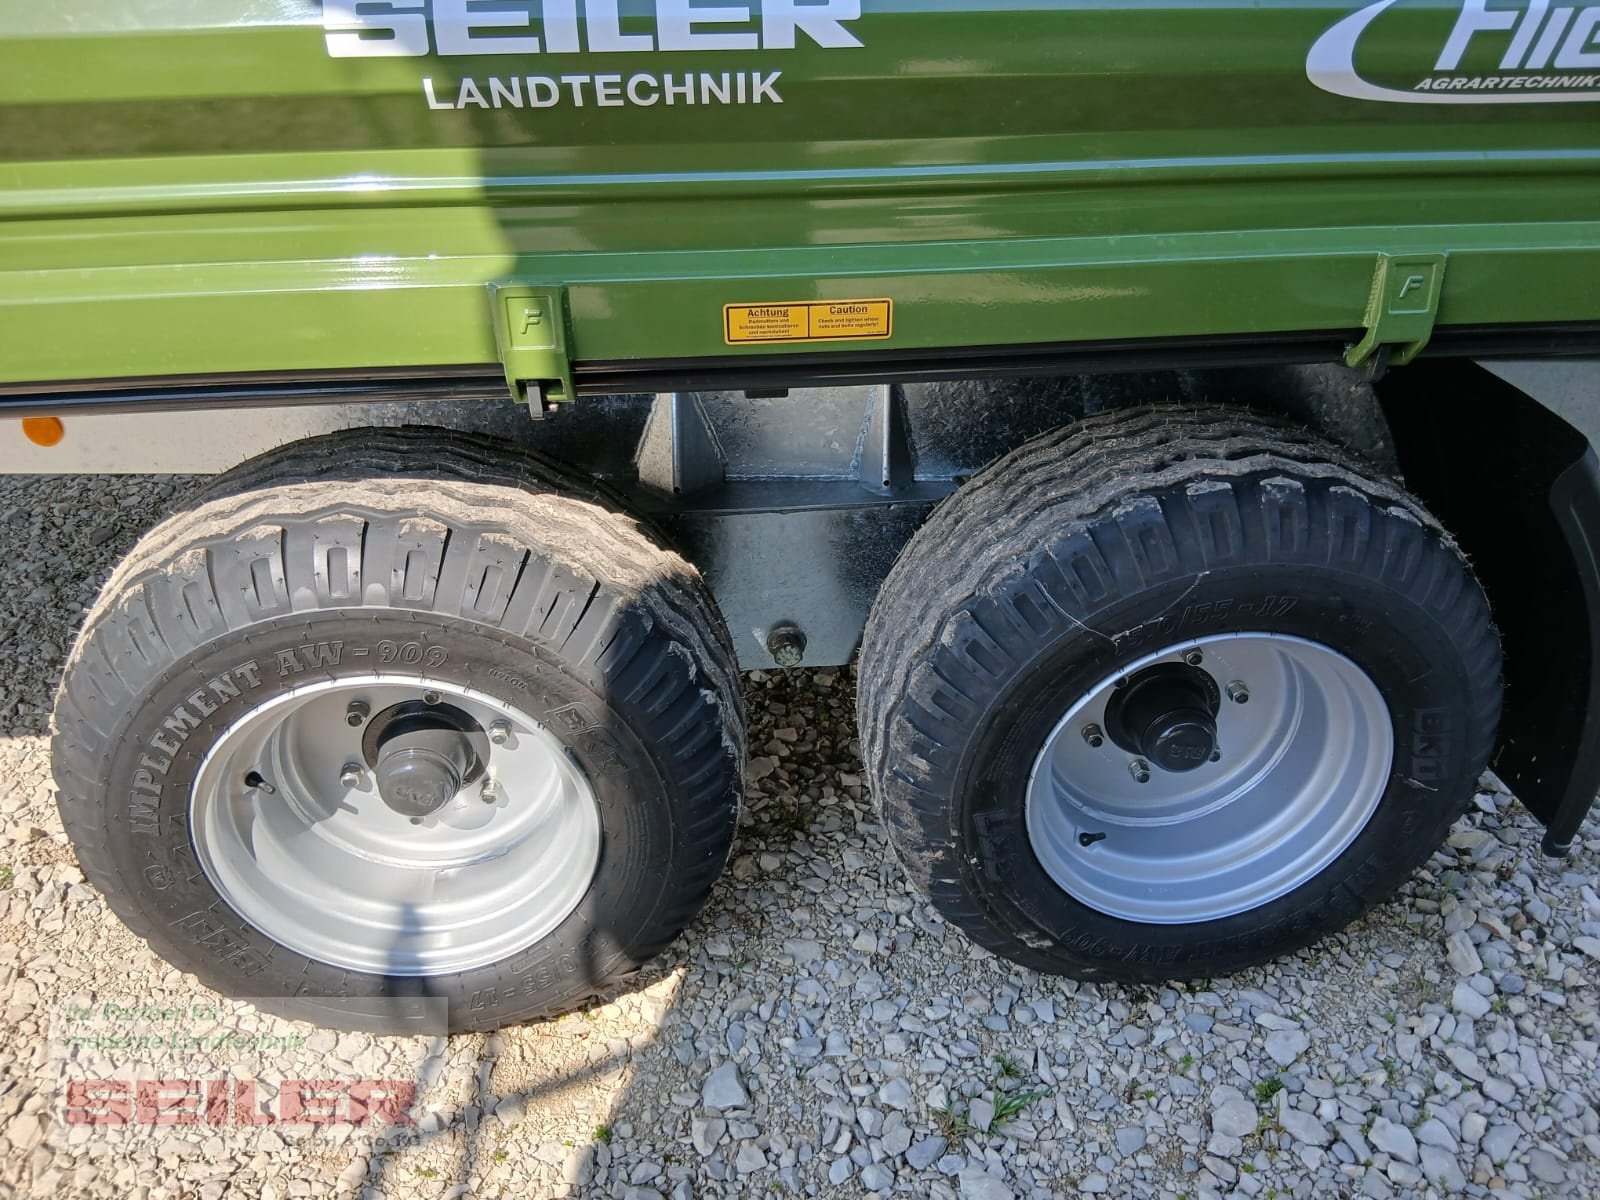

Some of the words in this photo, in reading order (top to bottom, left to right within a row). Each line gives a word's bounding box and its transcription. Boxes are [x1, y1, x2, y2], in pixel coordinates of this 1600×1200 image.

[323, 0, 865, 58] SEILER
[422, 71, 784, 110] LANDTECHNIK
[1399, 274, 1425, 299] F
[520, 308, 543, 335] F
[748, 308, 790, 318] Achtung
[829, 304, 868, 315] Caution
[128, 660, 263, 836] IMPLEMENT
